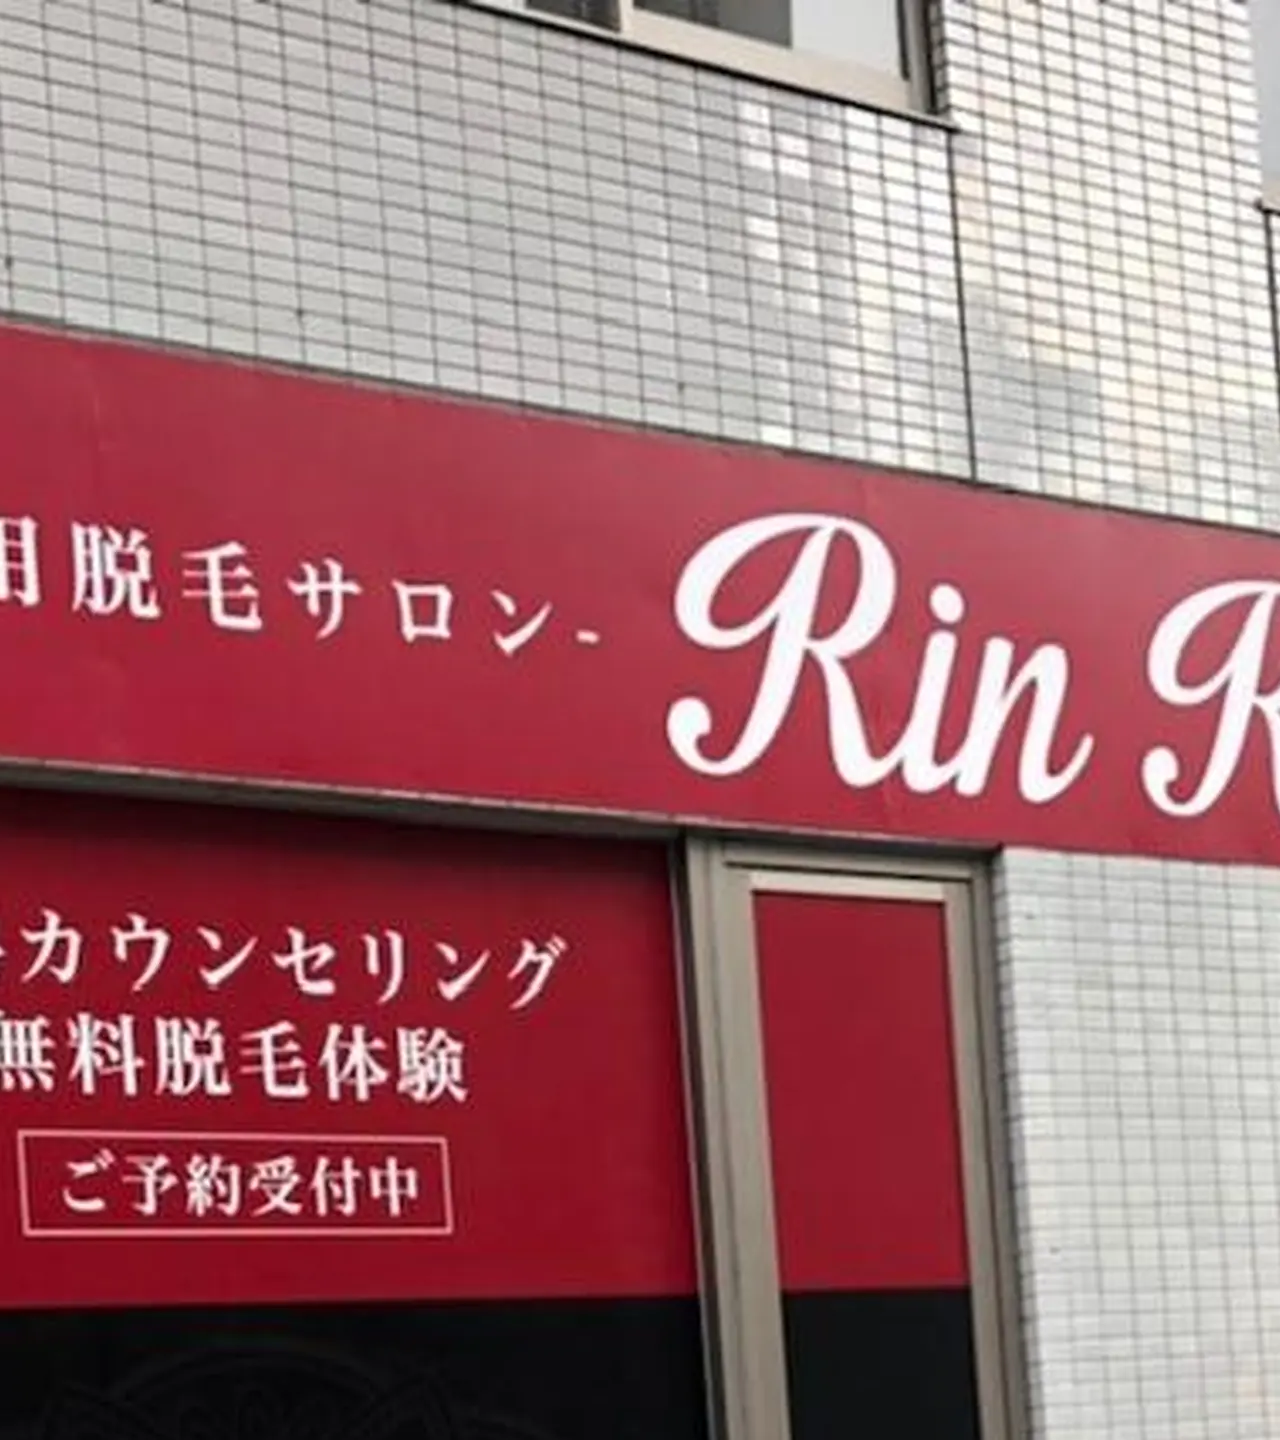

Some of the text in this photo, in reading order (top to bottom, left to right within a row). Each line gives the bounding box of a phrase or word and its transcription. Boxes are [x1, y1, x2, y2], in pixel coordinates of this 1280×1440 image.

[666, 512, 1094, 804] Rin
[63, 1150, 419, 1216] ご予約受付中
